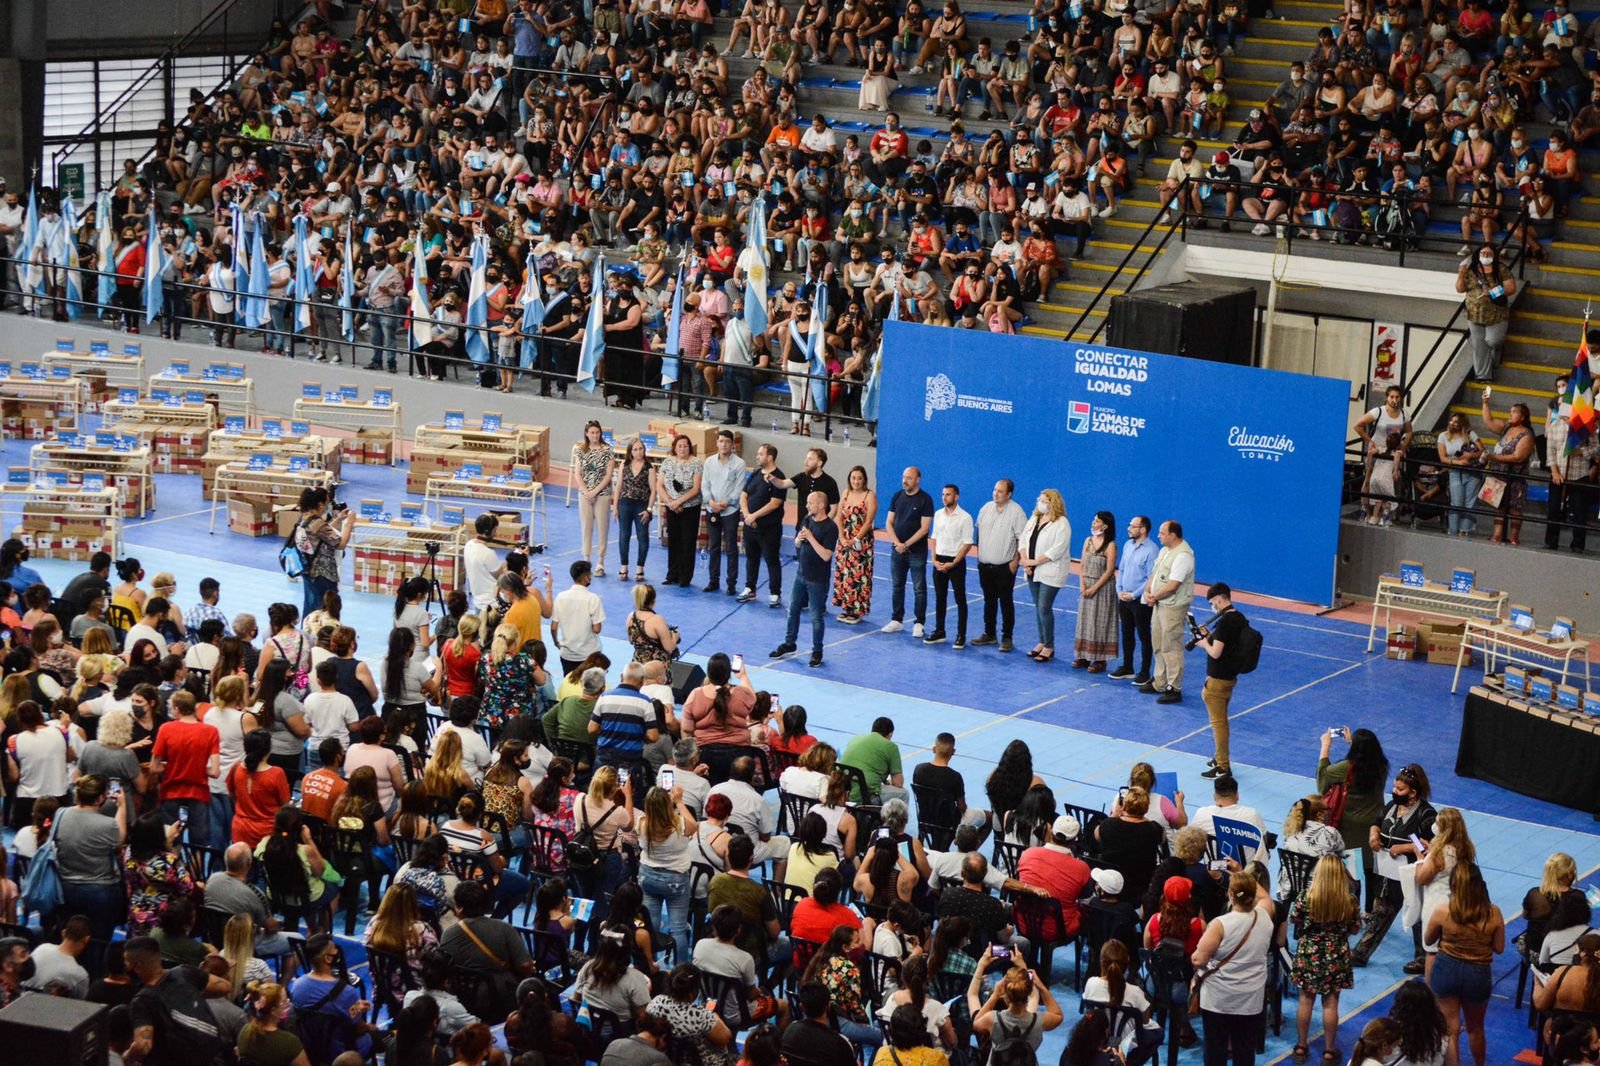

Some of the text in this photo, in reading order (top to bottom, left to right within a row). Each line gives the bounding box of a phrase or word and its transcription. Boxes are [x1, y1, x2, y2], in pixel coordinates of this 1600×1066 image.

[1075, 349, 1148, 369] CONECTAR
[1075, 361, 1148, 382] IGUALDAD
[1087, 379, 1132, 396] LOMAS
[957, 398, 1013, 414] BUENOS AIRES
[1092, 411, 1146, 428] LOMAS DE
[1092, 421, 1138, 437] ZAMORA
[1228, 426, 1295, 452] Educación
[1242, 452, 1279, 461] LOMAS
[1219, 825, 1231, 834] YO
